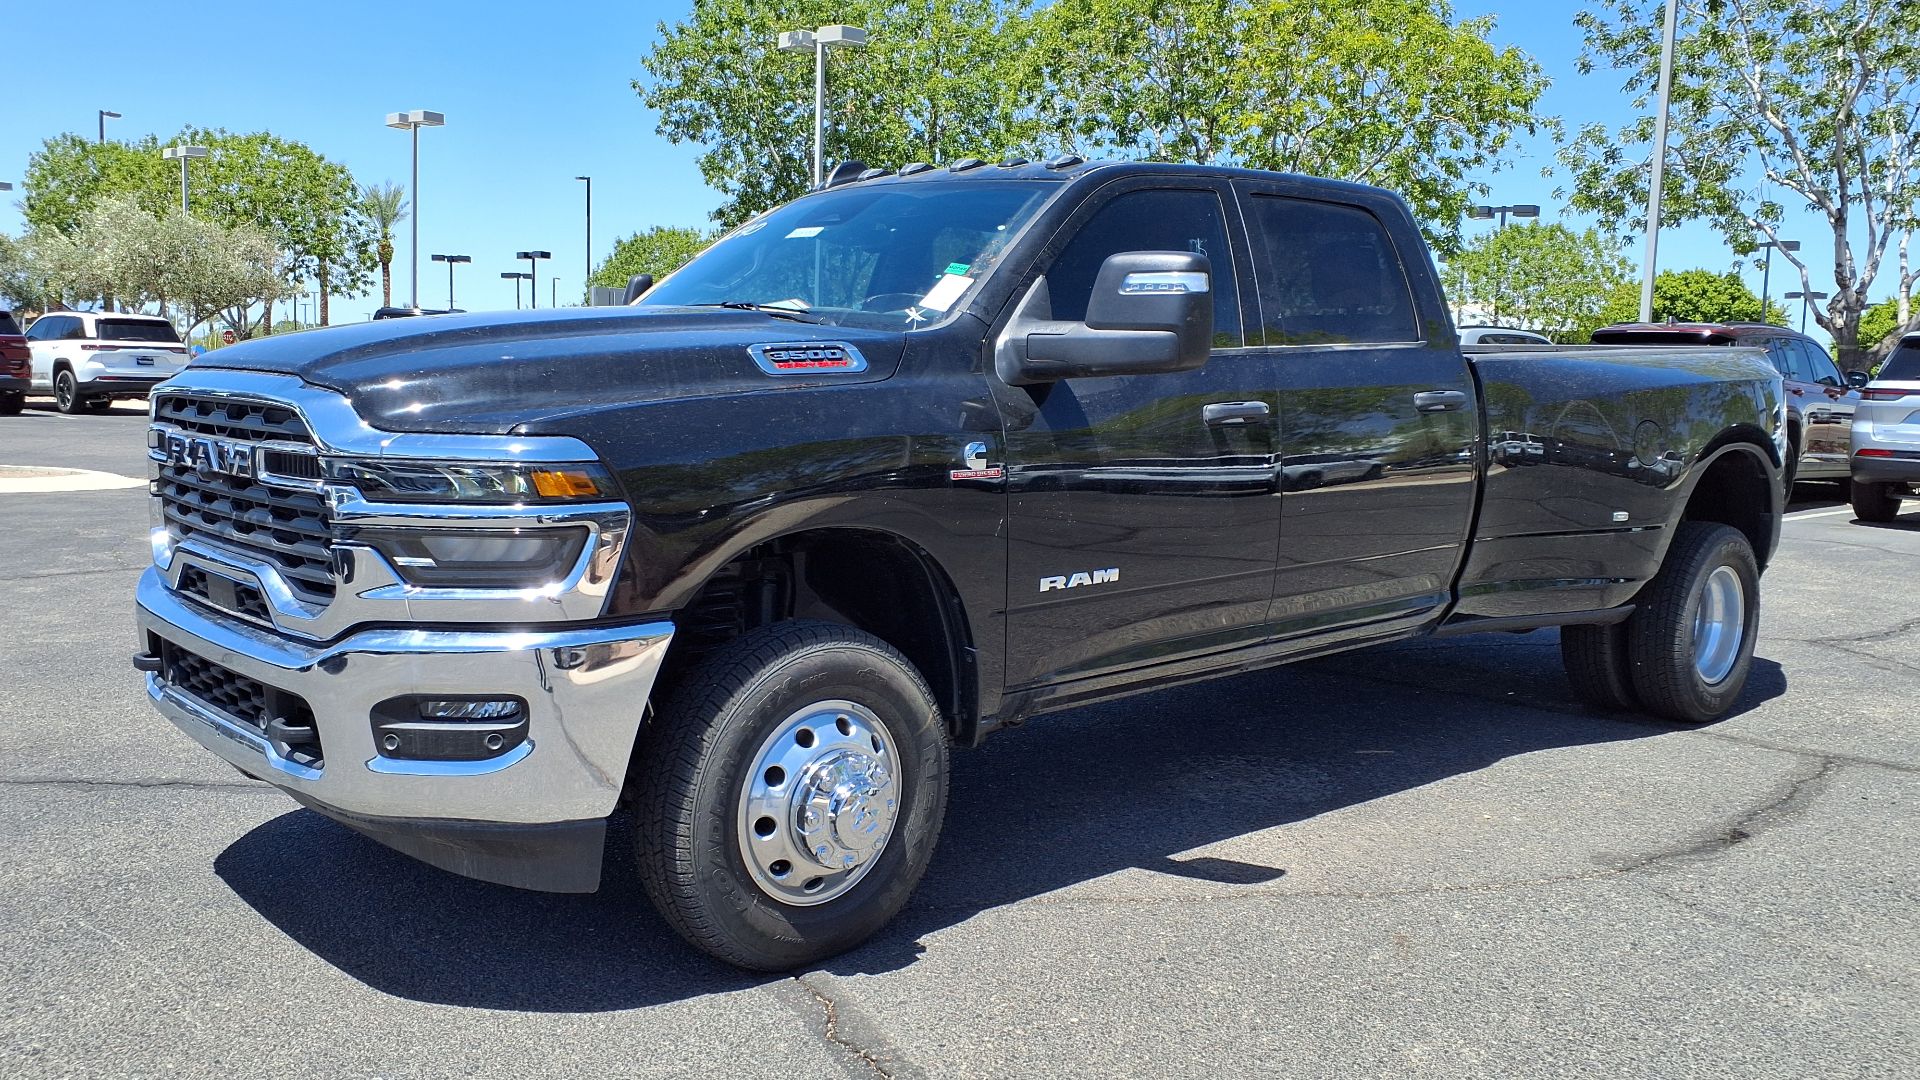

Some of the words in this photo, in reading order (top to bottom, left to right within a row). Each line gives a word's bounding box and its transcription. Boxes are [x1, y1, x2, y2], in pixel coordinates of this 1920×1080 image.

[770, 349, 843, 362] 3500
[167, 432, 251, 477] RAM
[977, 469, 1000, 477] DIESEL
[1040, 567, 1119, 592] RAM
